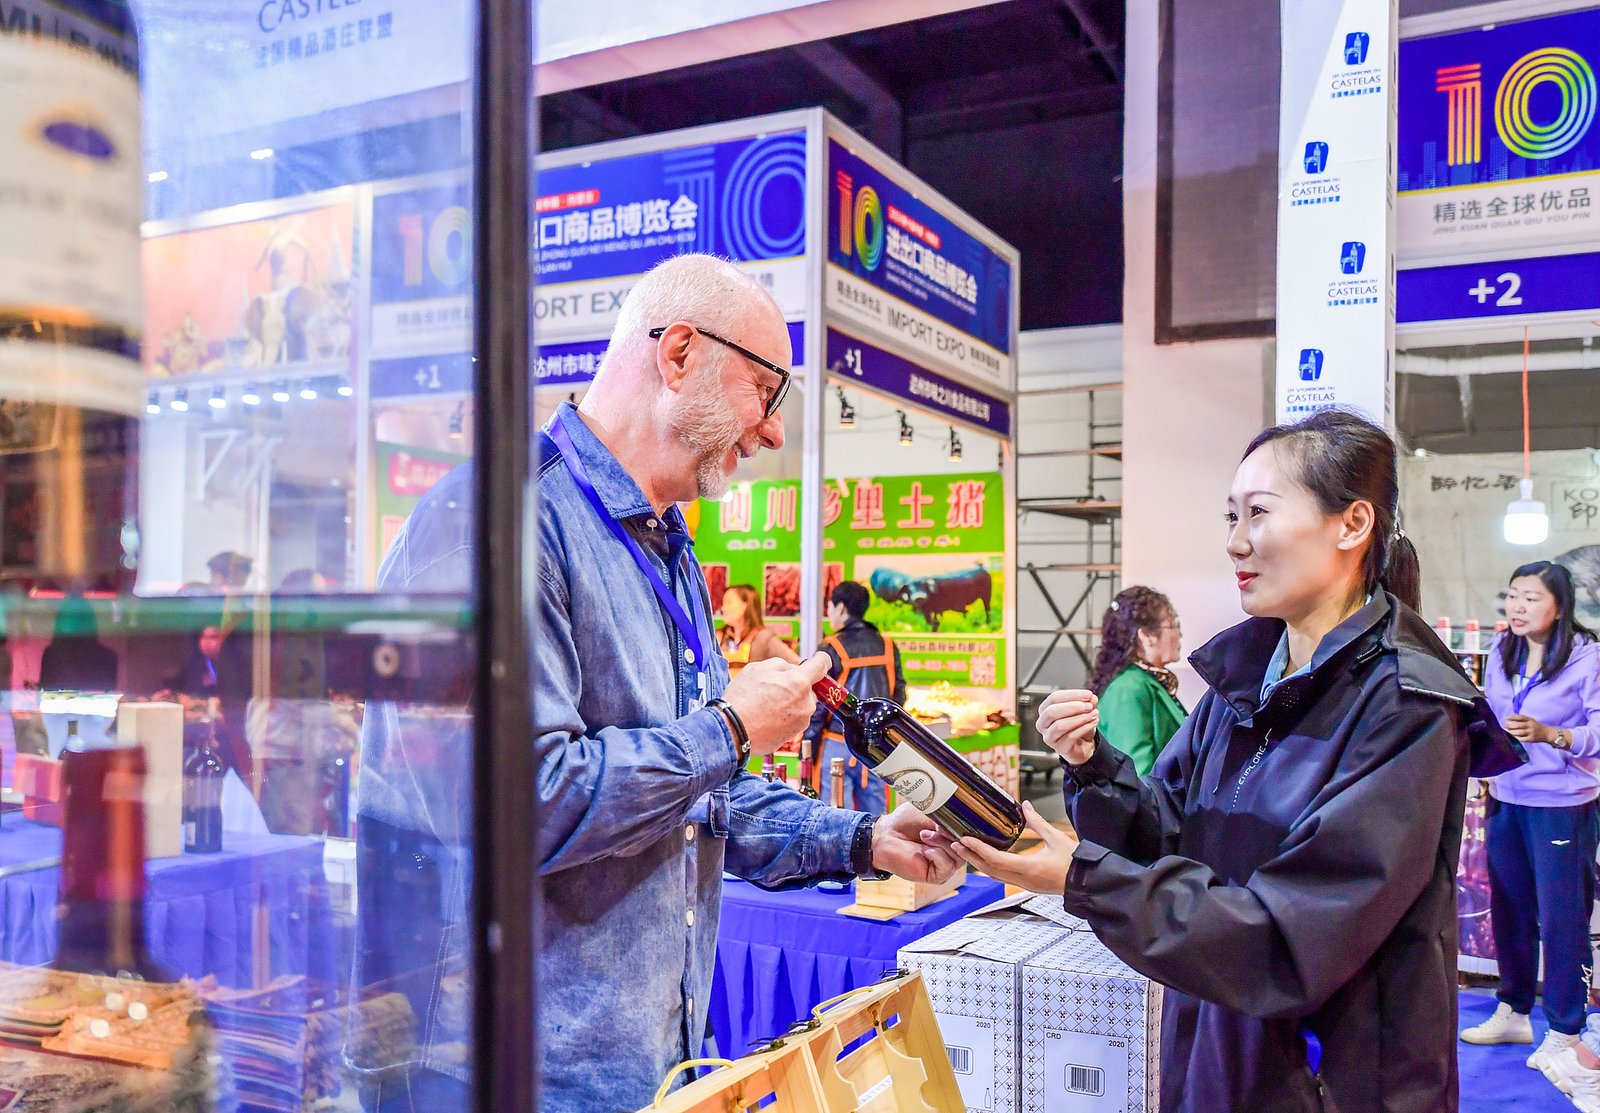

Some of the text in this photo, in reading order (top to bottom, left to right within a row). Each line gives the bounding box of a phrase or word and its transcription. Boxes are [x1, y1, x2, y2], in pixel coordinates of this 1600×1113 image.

[1331, 74, 1381, 90] CASTELAS
[1435, 46, 1598, 167] 10
[1291, 184, 1340, 198] CASTELAS
[1432, 187, 1591, 222] 精选全球优品
[533, 193, 698, 249] 口商品博览会
[837, 170, 885, 272] 10
[1460, 223, 1488, 232] XUAN
[1491, 220, 1521, 229] QUAN
[1547, 215, 1568, 223] YOU
[1572, 212, 1591, 220] PIN
[886, 223, 978, 304] 进出口商品博览会
[591, 288, 631, 314] EX
[1328, 285, 1378, 298] CASTELAS
[1468, 272, 1523, 307] +2
[888, 307, 933, 345] IMPORT
[937, 331, 966, 361] EXPO
[844, 347, 864, 376] +1
[414, 364, 442, 389] +1
[1287, 392, 1335, 404] CASTELAS
[976, 1021, 991, 1029] 2020
[1046, 1032, 1062, 1040] CRD
[1108, 1040, 1125, 1048] 2020
